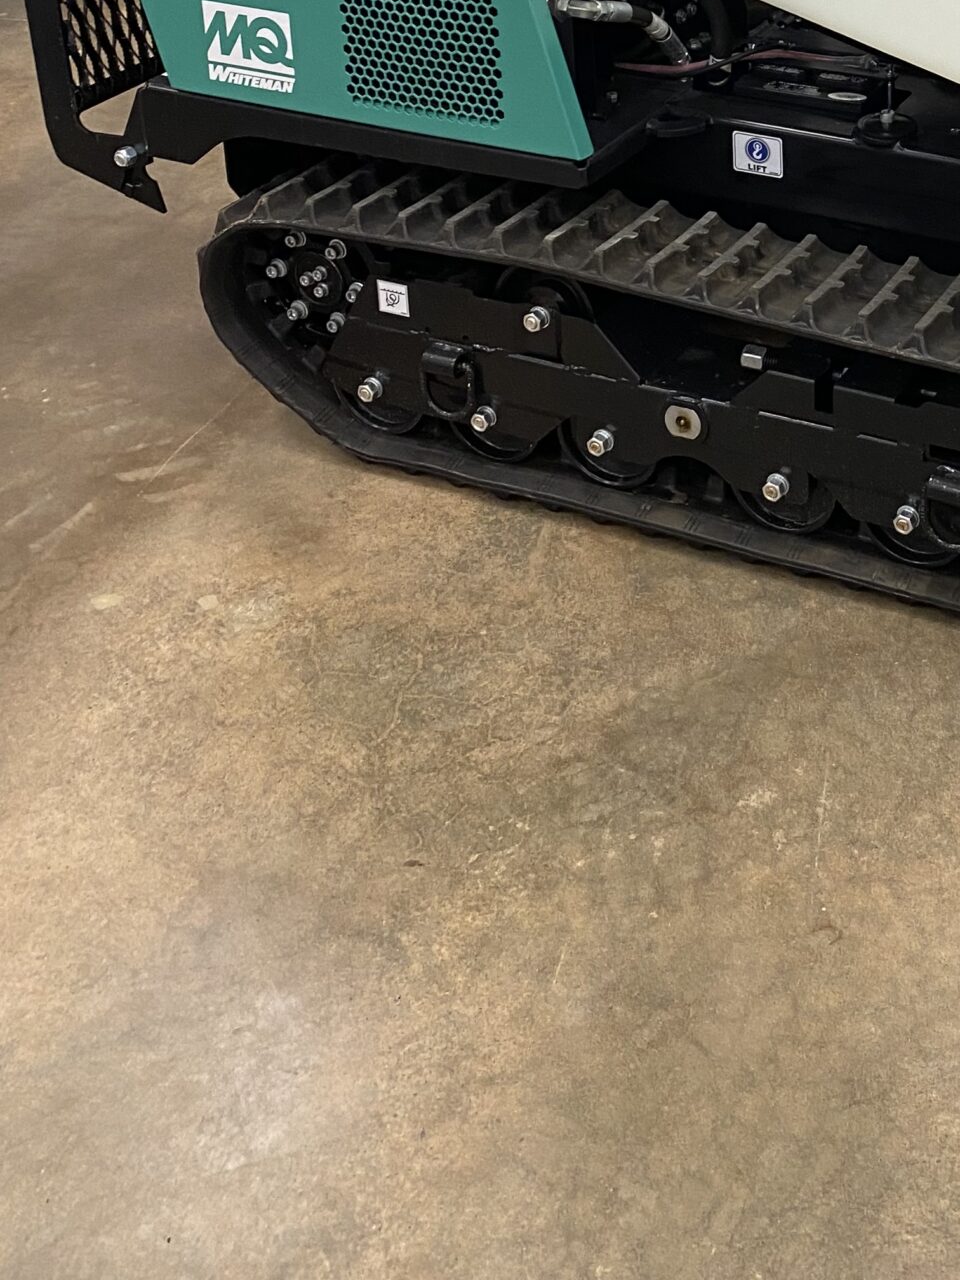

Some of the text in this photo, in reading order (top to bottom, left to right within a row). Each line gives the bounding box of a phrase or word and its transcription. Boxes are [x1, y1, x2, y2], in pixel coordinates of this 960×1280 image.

[204, 8, 295, 68] MQ
[208, 63, 296, 94] WHITEMAN
[748, 163, 767, 173] LIFT
